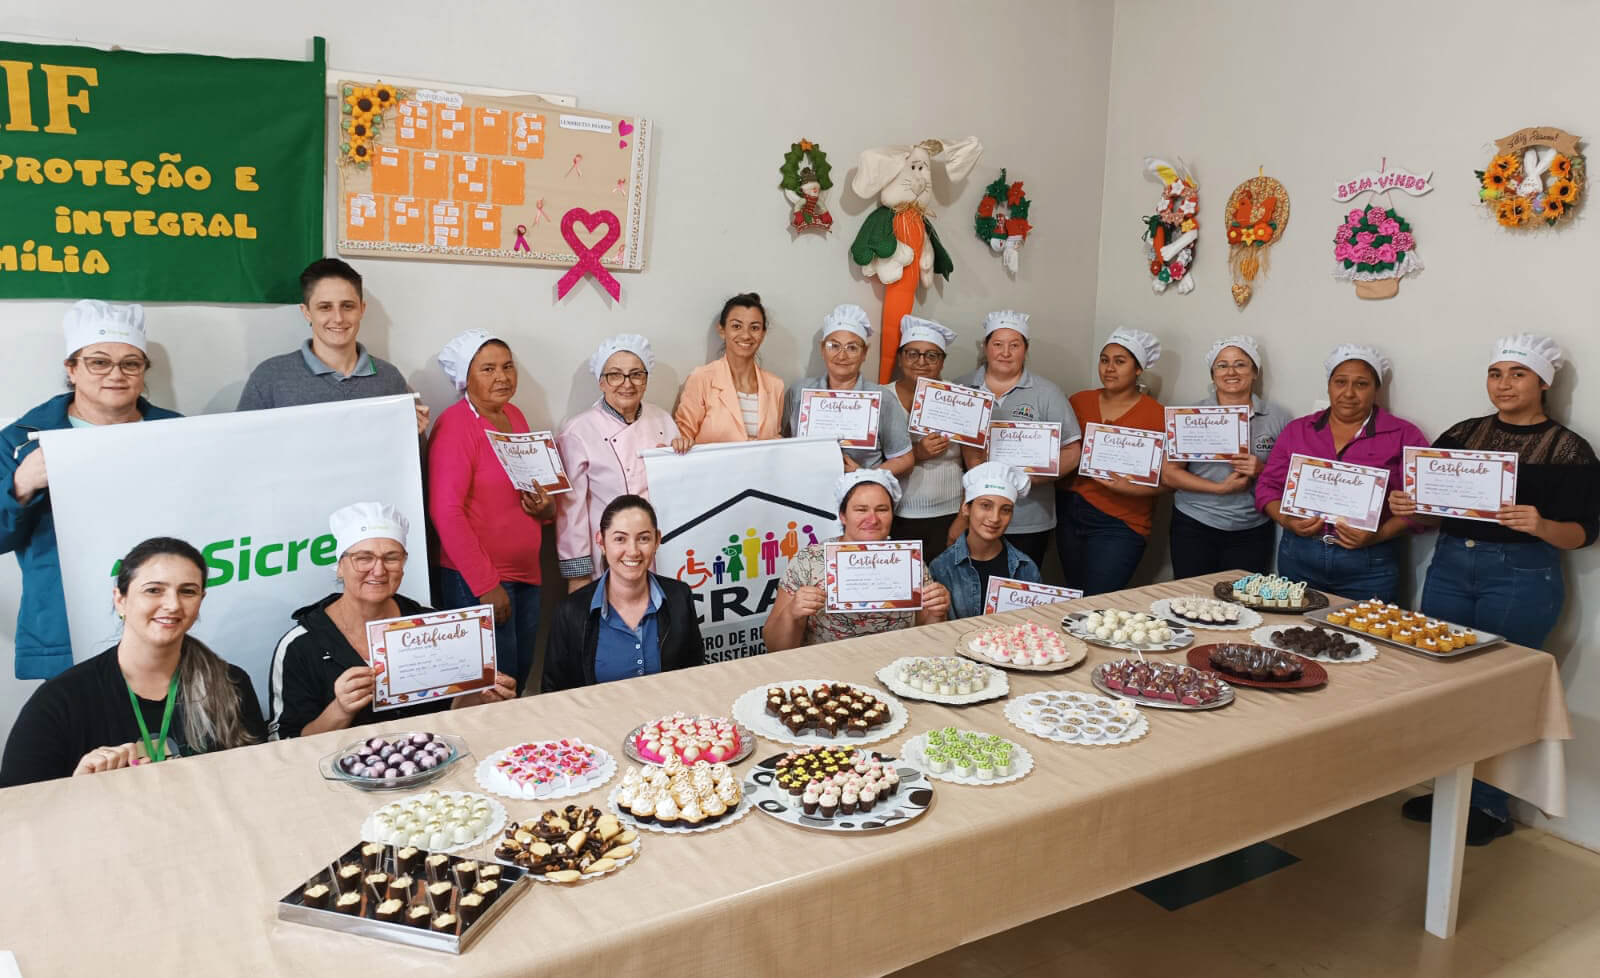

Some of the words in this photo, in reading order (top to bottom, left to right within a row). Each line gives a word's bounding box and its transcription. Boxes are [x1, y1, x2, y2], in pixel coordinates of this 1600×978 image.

[0, 60, 99, 135] IF
[235, 166, 259, 191] E
[1185, 415, 1229, 429] Certificado
[1103, 433, 1145, 449] Certificado
[1429, 459, 1490, 477] Certificado
[1312, 468, 1365, 487] Certificado
[848, 552, 901, 569] Certificado
[401, 623, 468, 648] Certificado
[729, 629, 746, 646] DE
